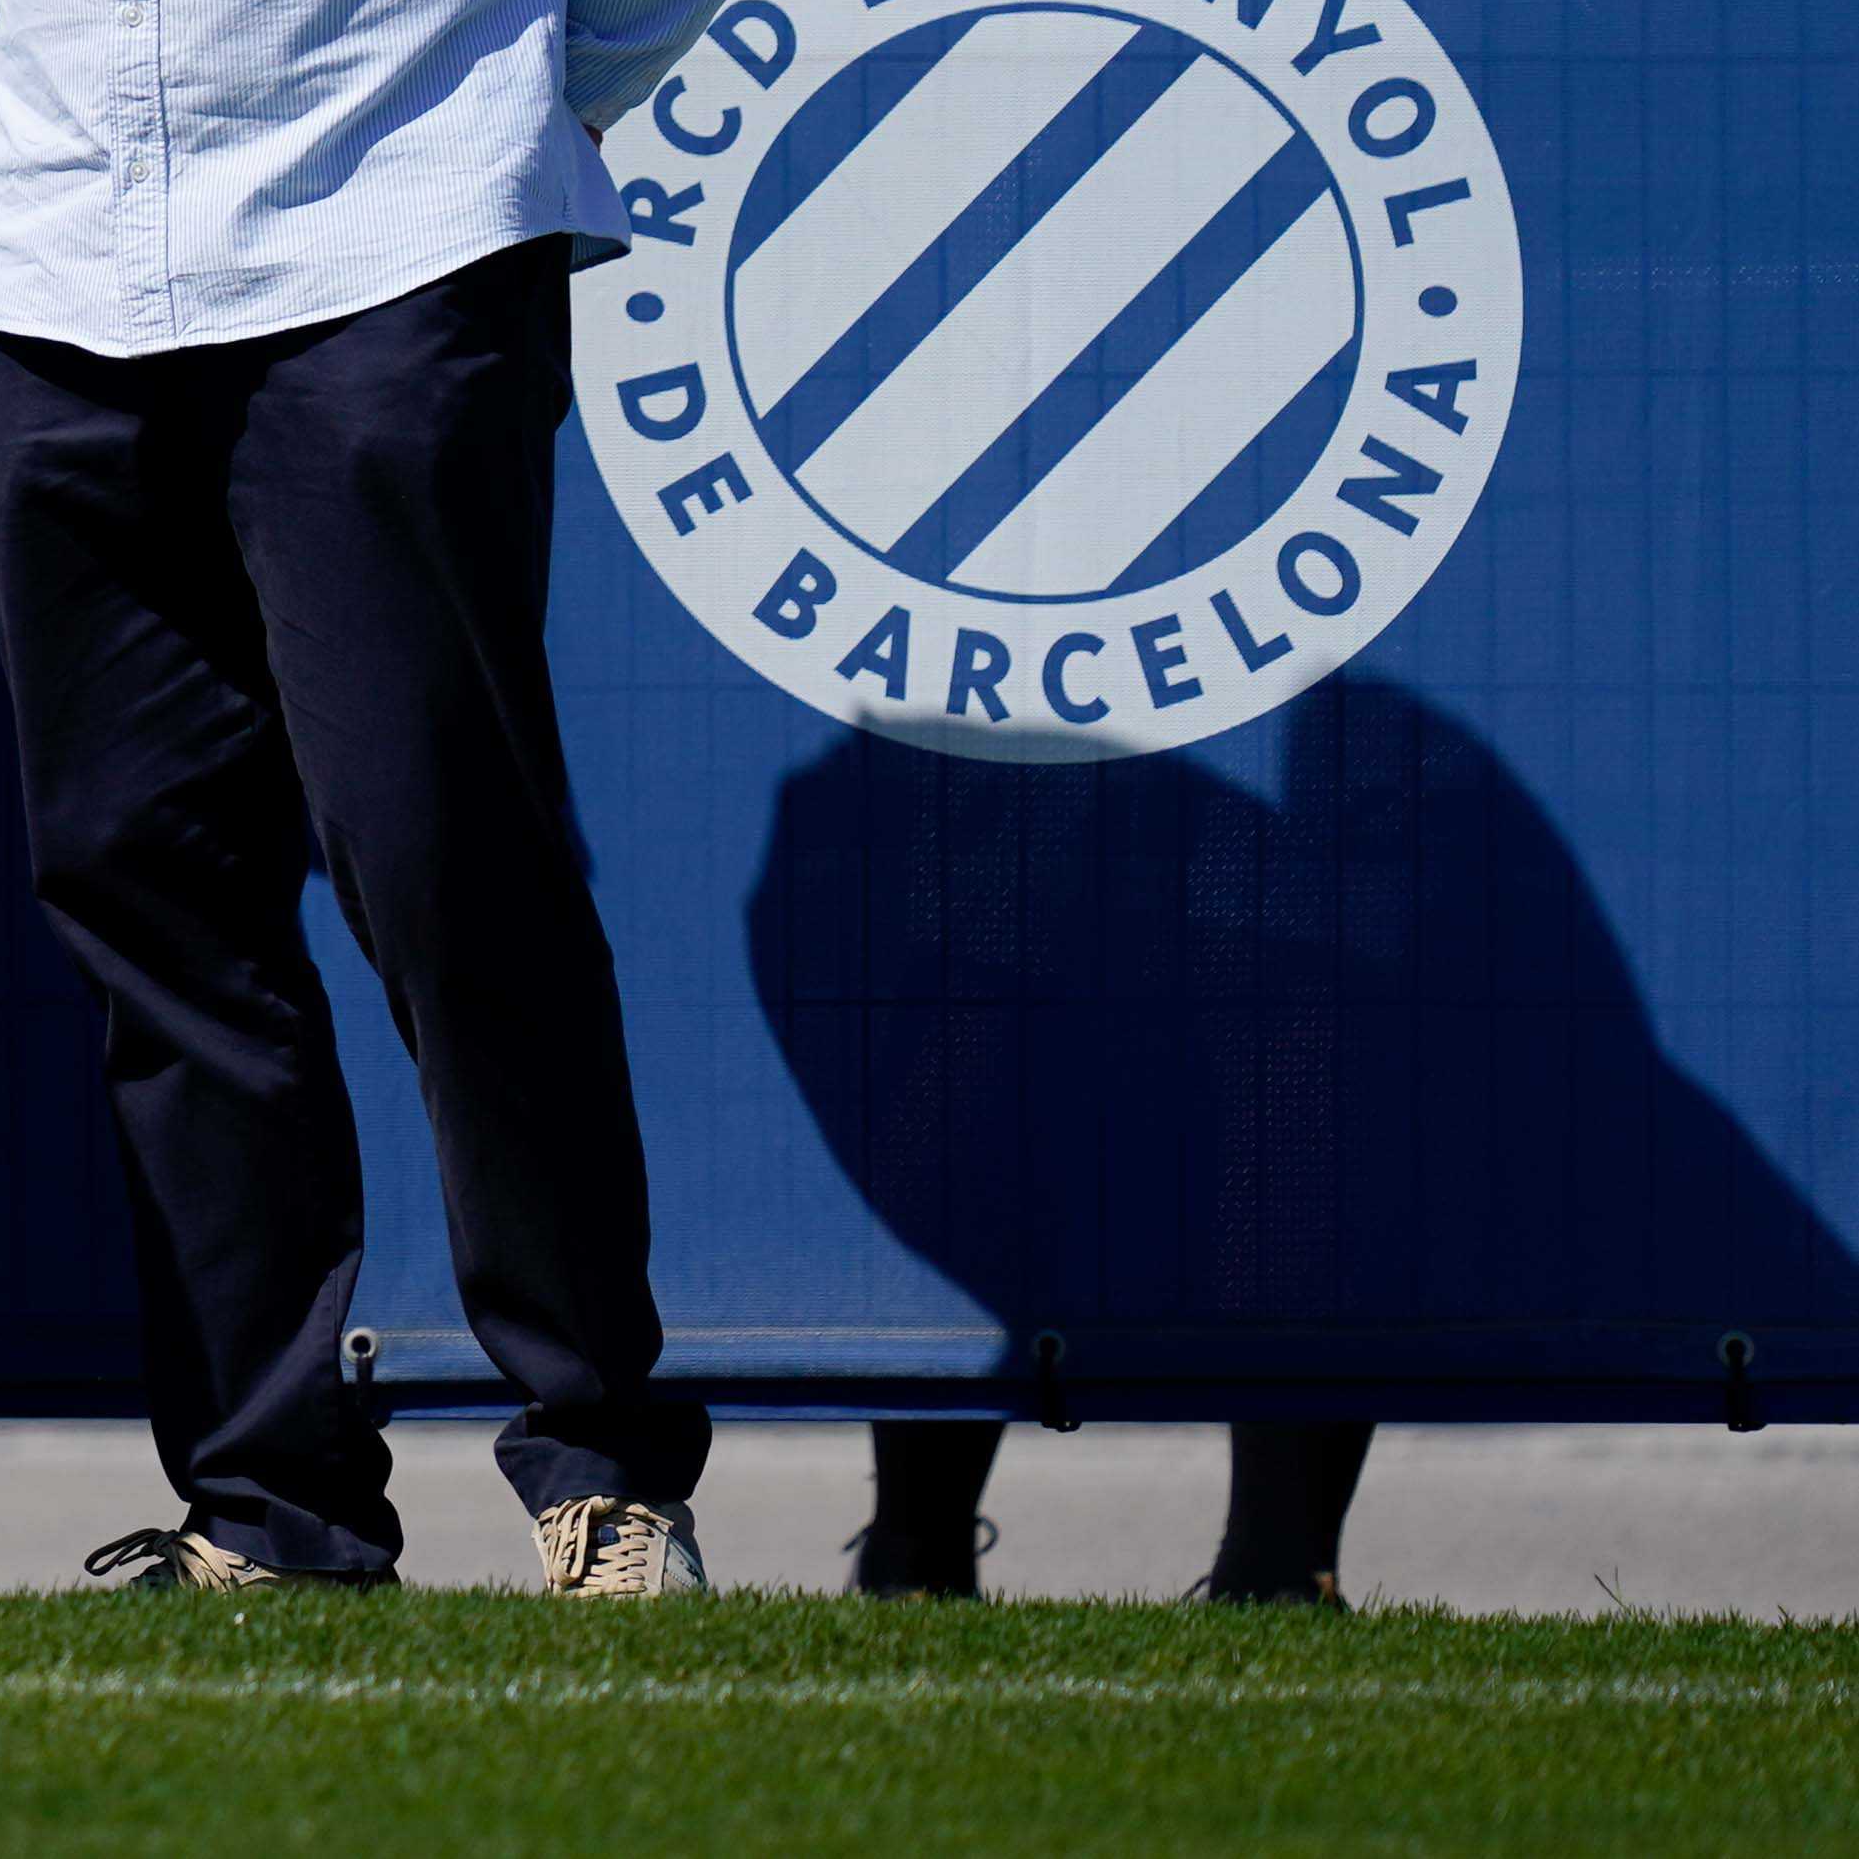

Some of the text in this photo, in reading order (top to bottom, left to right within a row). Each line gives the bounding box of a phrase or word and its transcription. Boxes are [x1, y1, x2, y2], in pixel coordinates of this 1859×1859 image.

[619, 0, 797, 247] RCD
[616, 358, 1478, 724] DE BARCELONA
